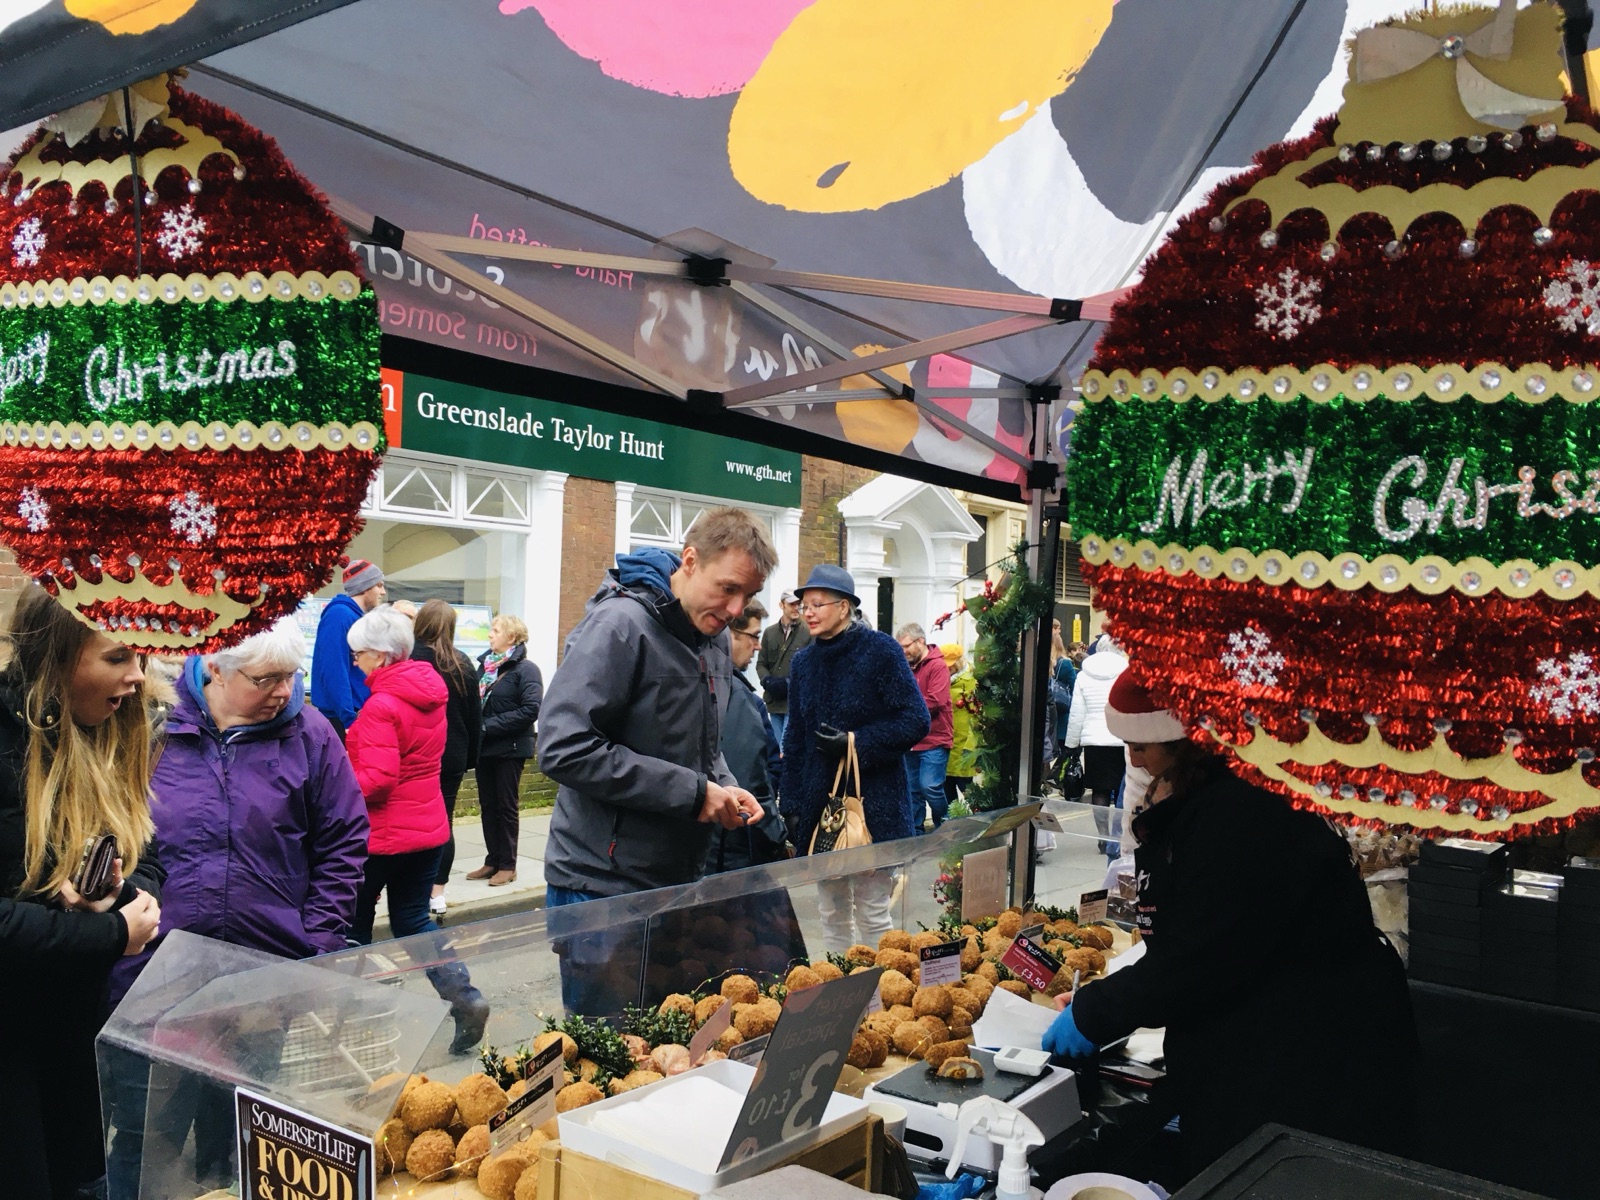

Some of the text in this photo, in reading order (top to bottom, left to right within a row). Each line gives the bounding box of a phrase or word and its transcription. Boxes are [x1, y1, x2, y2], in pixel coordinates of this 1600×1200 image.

[0, 330, 50, 398] erry
[85, 340, 297, 412] Christmas
[417, 392, 544, 439] Greenslade
[551, 417, 614, 451] Taylor
[619, 431, 665, 461] Hunt
[726, 461, 793, 484] www.gth.net
[1140, 446, 1315, 533] Merry
[1021, 968, 1046, 989] £3.50
[252, 1102, 356, 1167] SOMERSETLIFE
[256, 1136, 352, 1200] FOOD
[258, 1174, 276, 1200] &
